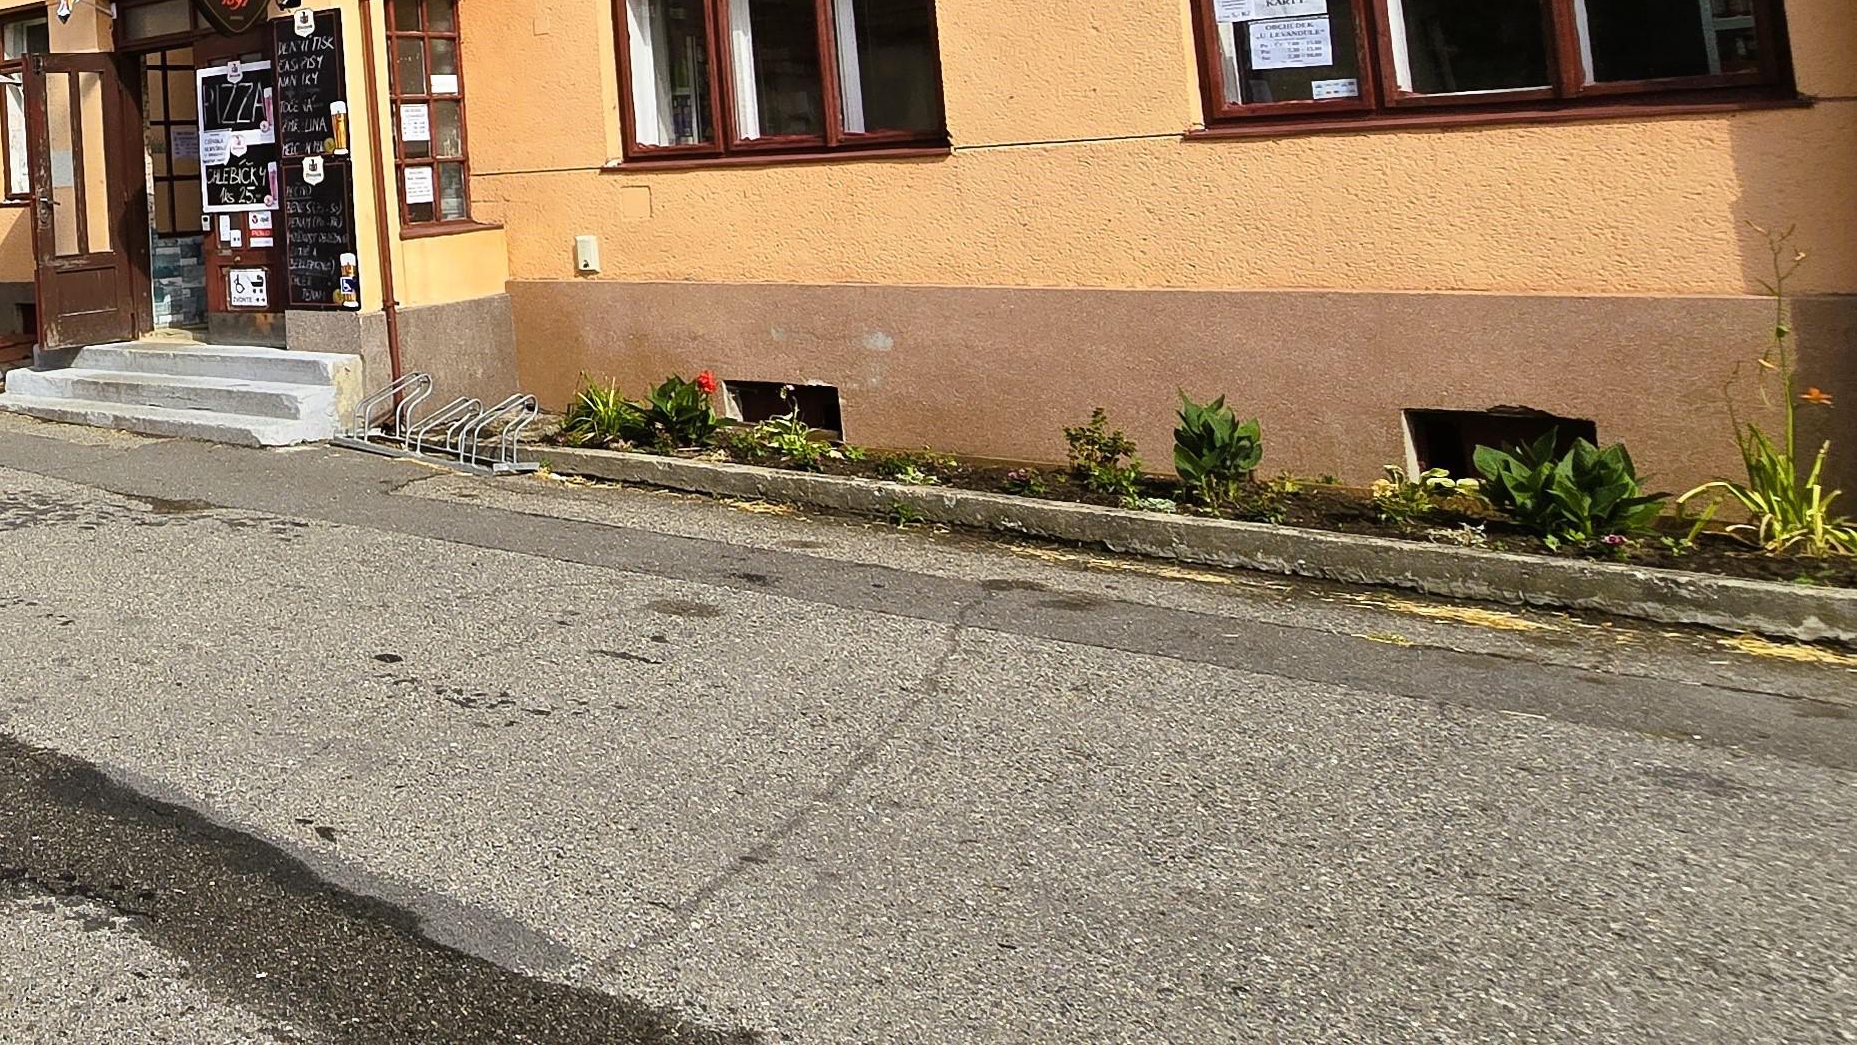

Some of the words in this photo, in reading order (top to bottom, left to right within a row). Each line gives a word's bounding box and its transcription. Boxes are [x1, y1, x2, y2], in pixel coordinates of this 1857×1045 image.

[278, 55, 324, 73] ČASPISY
[203, 82, 267, 124] PIZZA
[207, 159, 267, 187] CHLEBÍČKY
